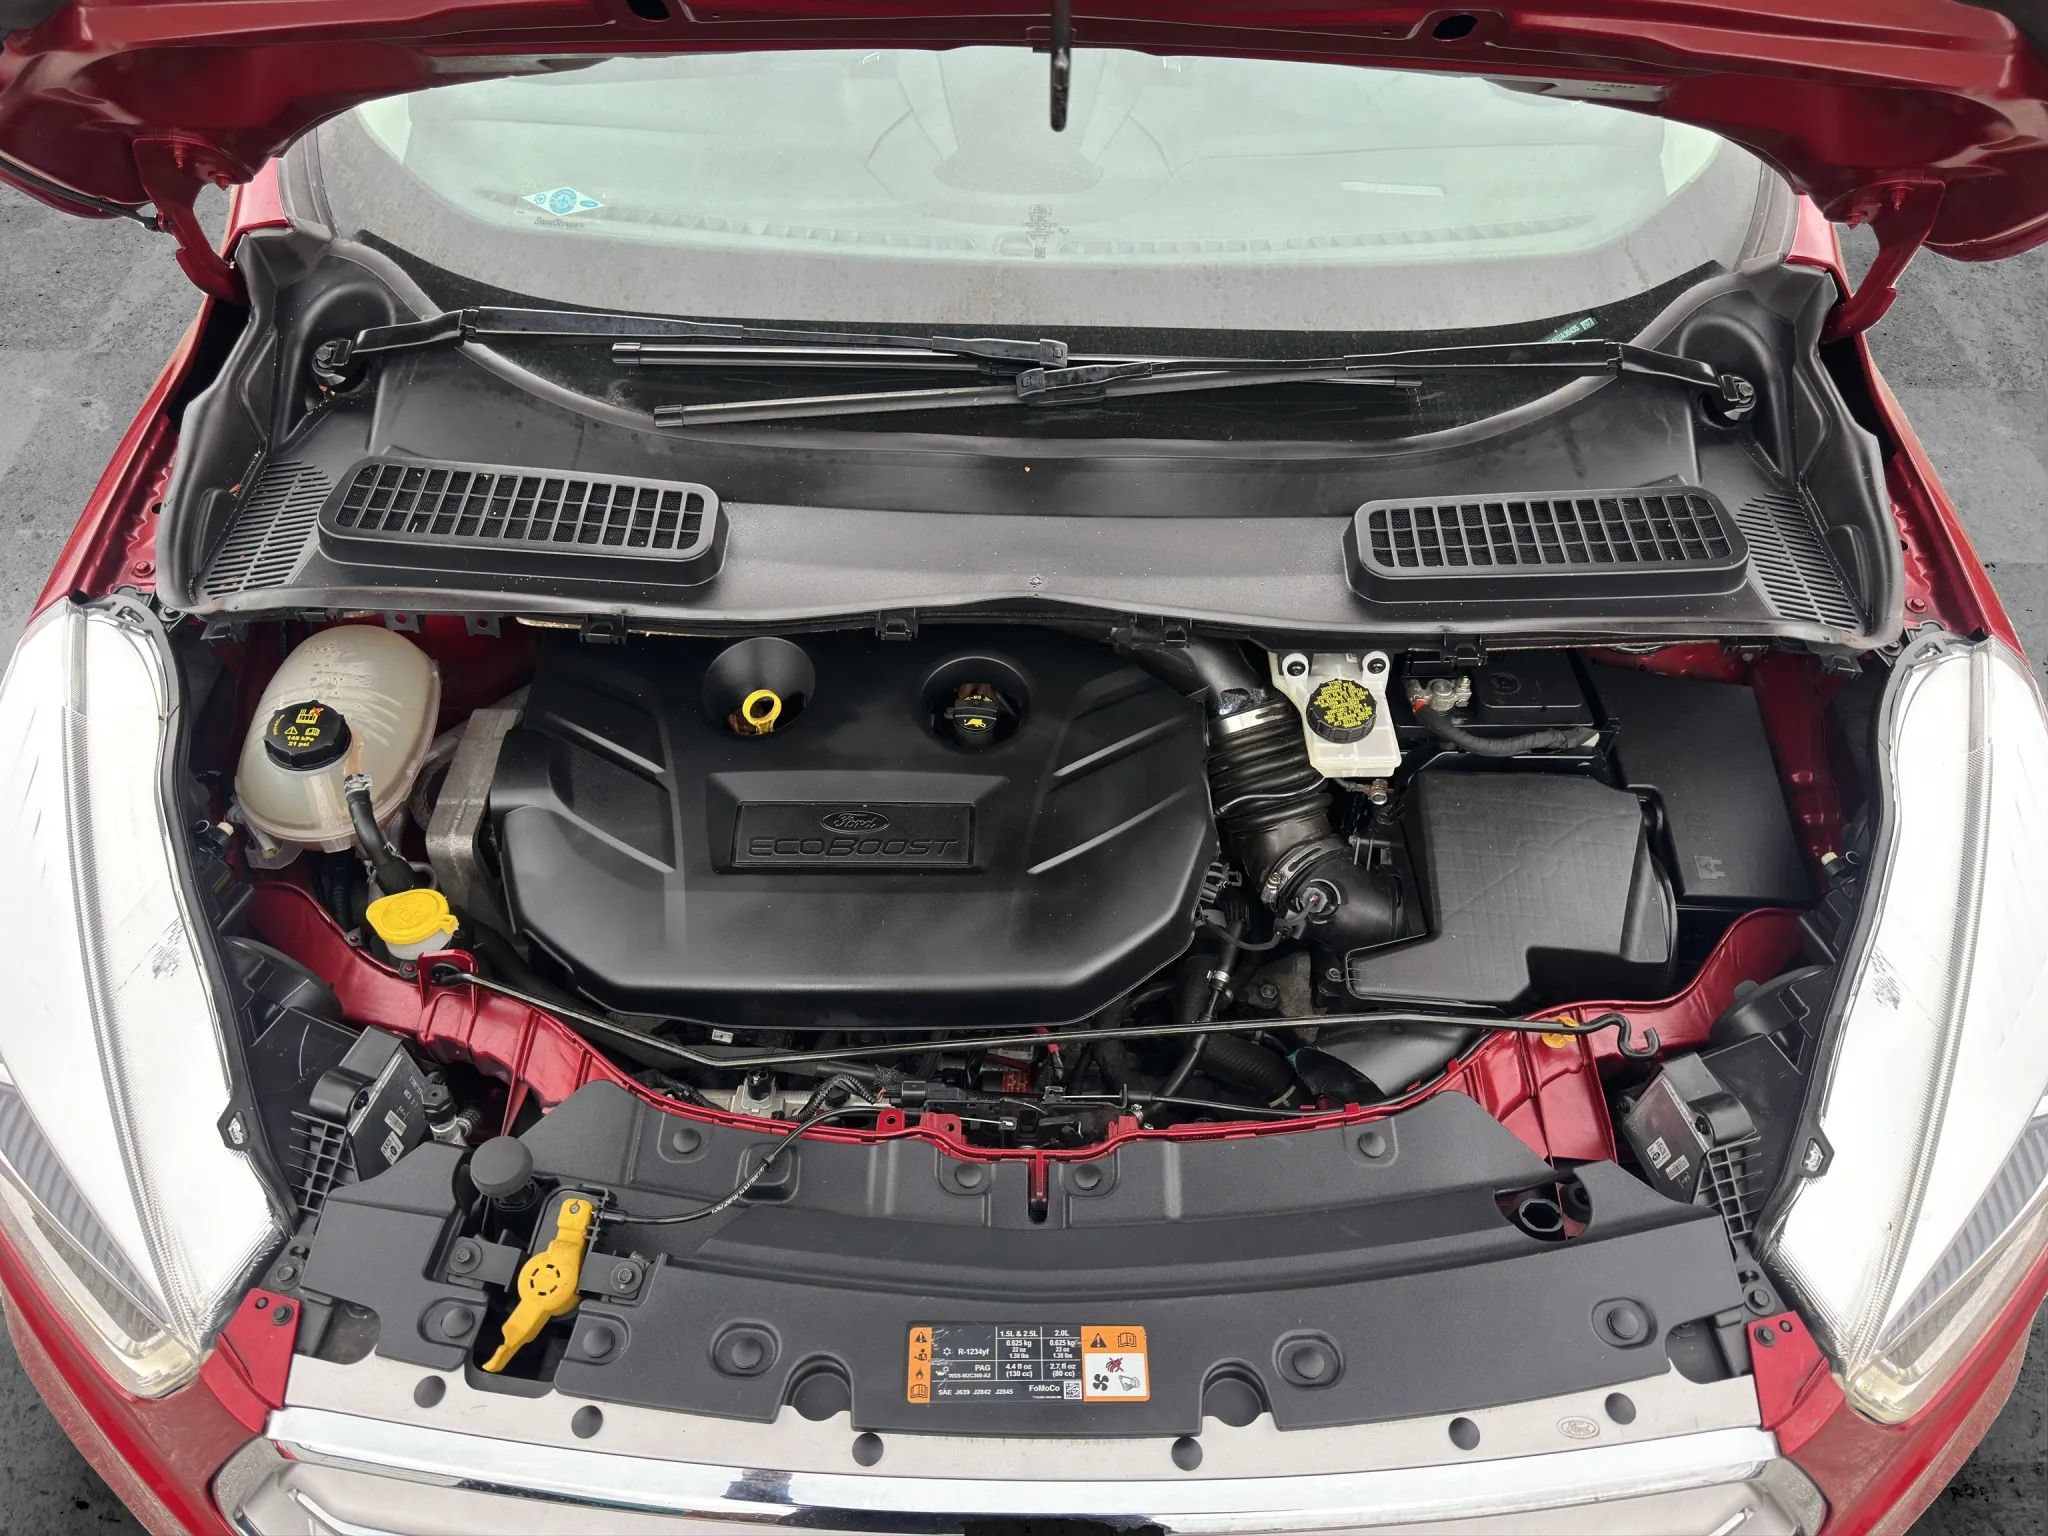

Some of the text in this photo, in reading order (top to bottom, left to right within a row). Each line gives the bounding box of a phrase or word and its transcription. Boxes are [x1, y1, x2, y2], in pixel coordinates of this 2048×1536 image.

[833, 813, 877, 830] Ford
[748, 836, 960, 857] ECOBOOST
[958, 1348, 989, 1356] R-1234yf
[974, 1364, 991, 1372] PAG
[1006, 1370, 1033, 1378] (130 cc)
[1052, 1370, 1075, 1378] (80 cc)
[1028, 1384, 1061, 1392] FoMoCo
